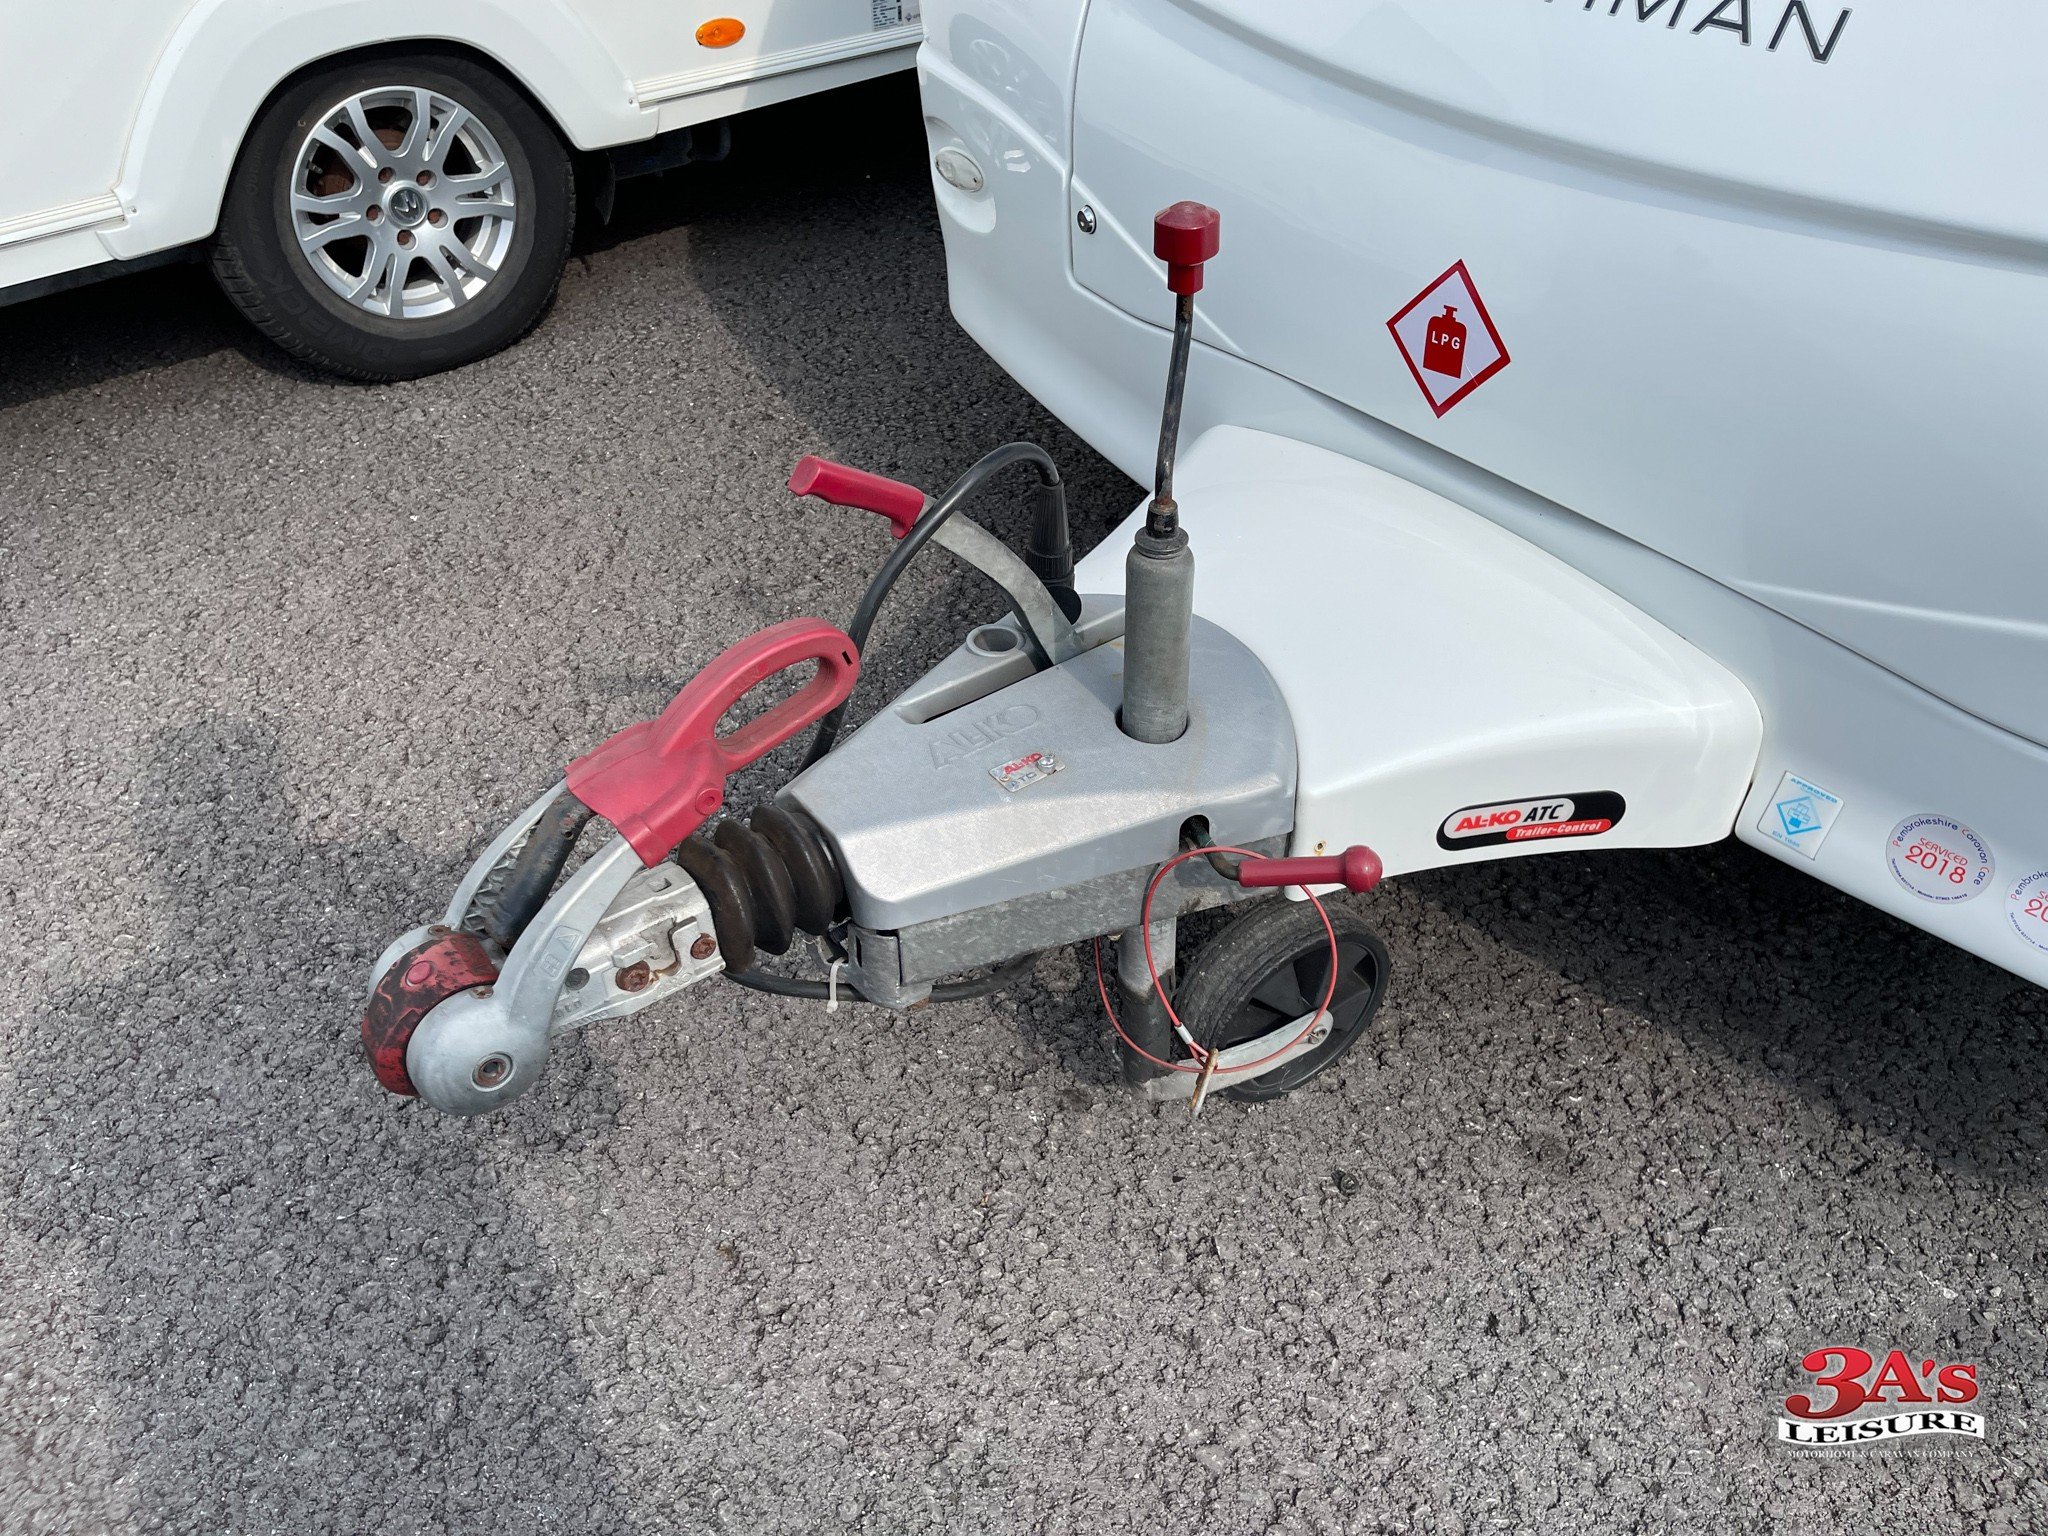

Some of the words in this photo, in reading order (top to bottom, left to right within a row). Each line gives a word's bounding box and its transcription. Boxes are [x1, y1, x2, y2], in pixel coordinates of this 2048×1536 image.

[1545, 0, 1853, 64] AN
[1431, 330, 1461, 350] LPG
[1522, 804, 1565, 823] ATC
[1514, 820, 1603, 839] Trailer-Control
[1892, 817, 1959, 847] Pembrokeshire
[1917, 837, 1969, 866] SERVICED
[1961, 828, 1989, 864] Caravan
[1904, 845, 1967, 884] 2018
[1973, 866, 1990, 885] Care
